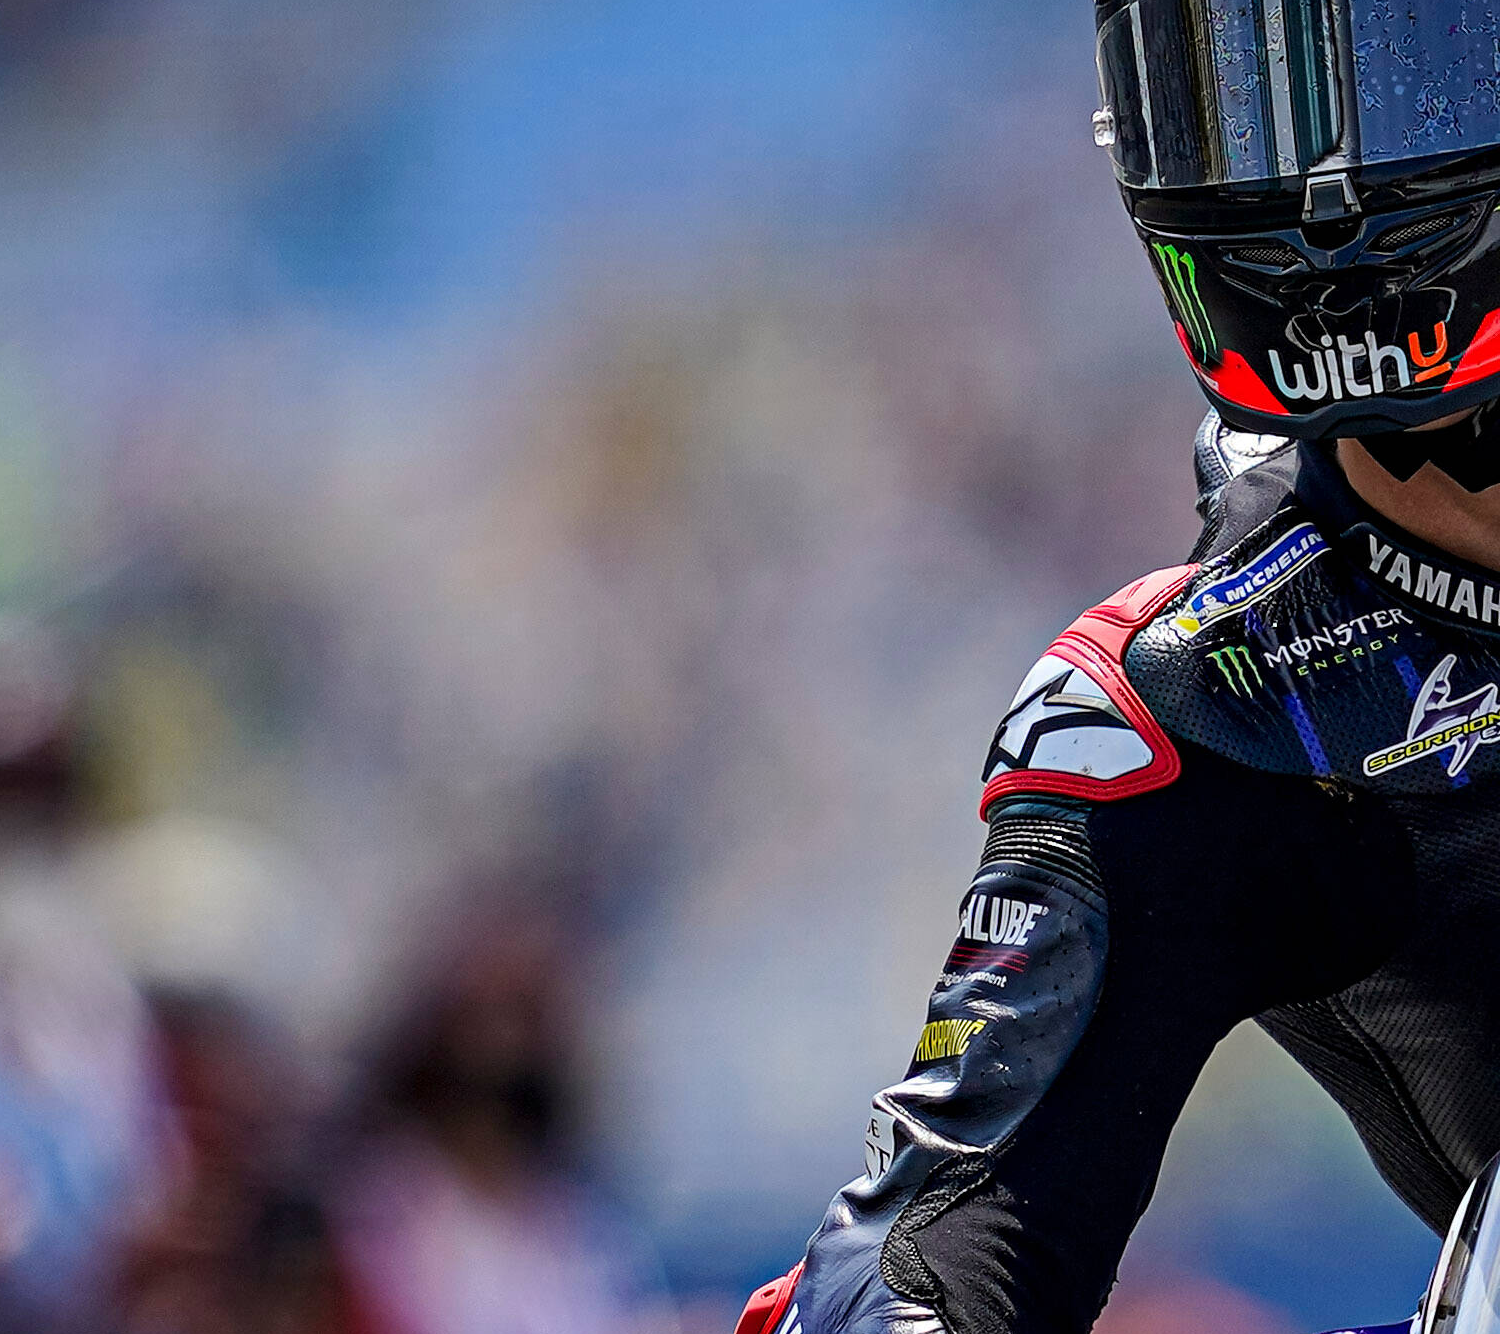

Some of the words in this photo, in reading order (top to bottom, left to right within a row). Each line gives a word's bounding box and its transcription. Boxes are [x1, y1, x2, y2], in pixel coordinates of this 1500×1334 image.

[1224, 531, 1326, 604] MICHELIN
[1263, 607, 1414, 669] MONSTER
[1296, 634, 1402, 677] ENERGY
